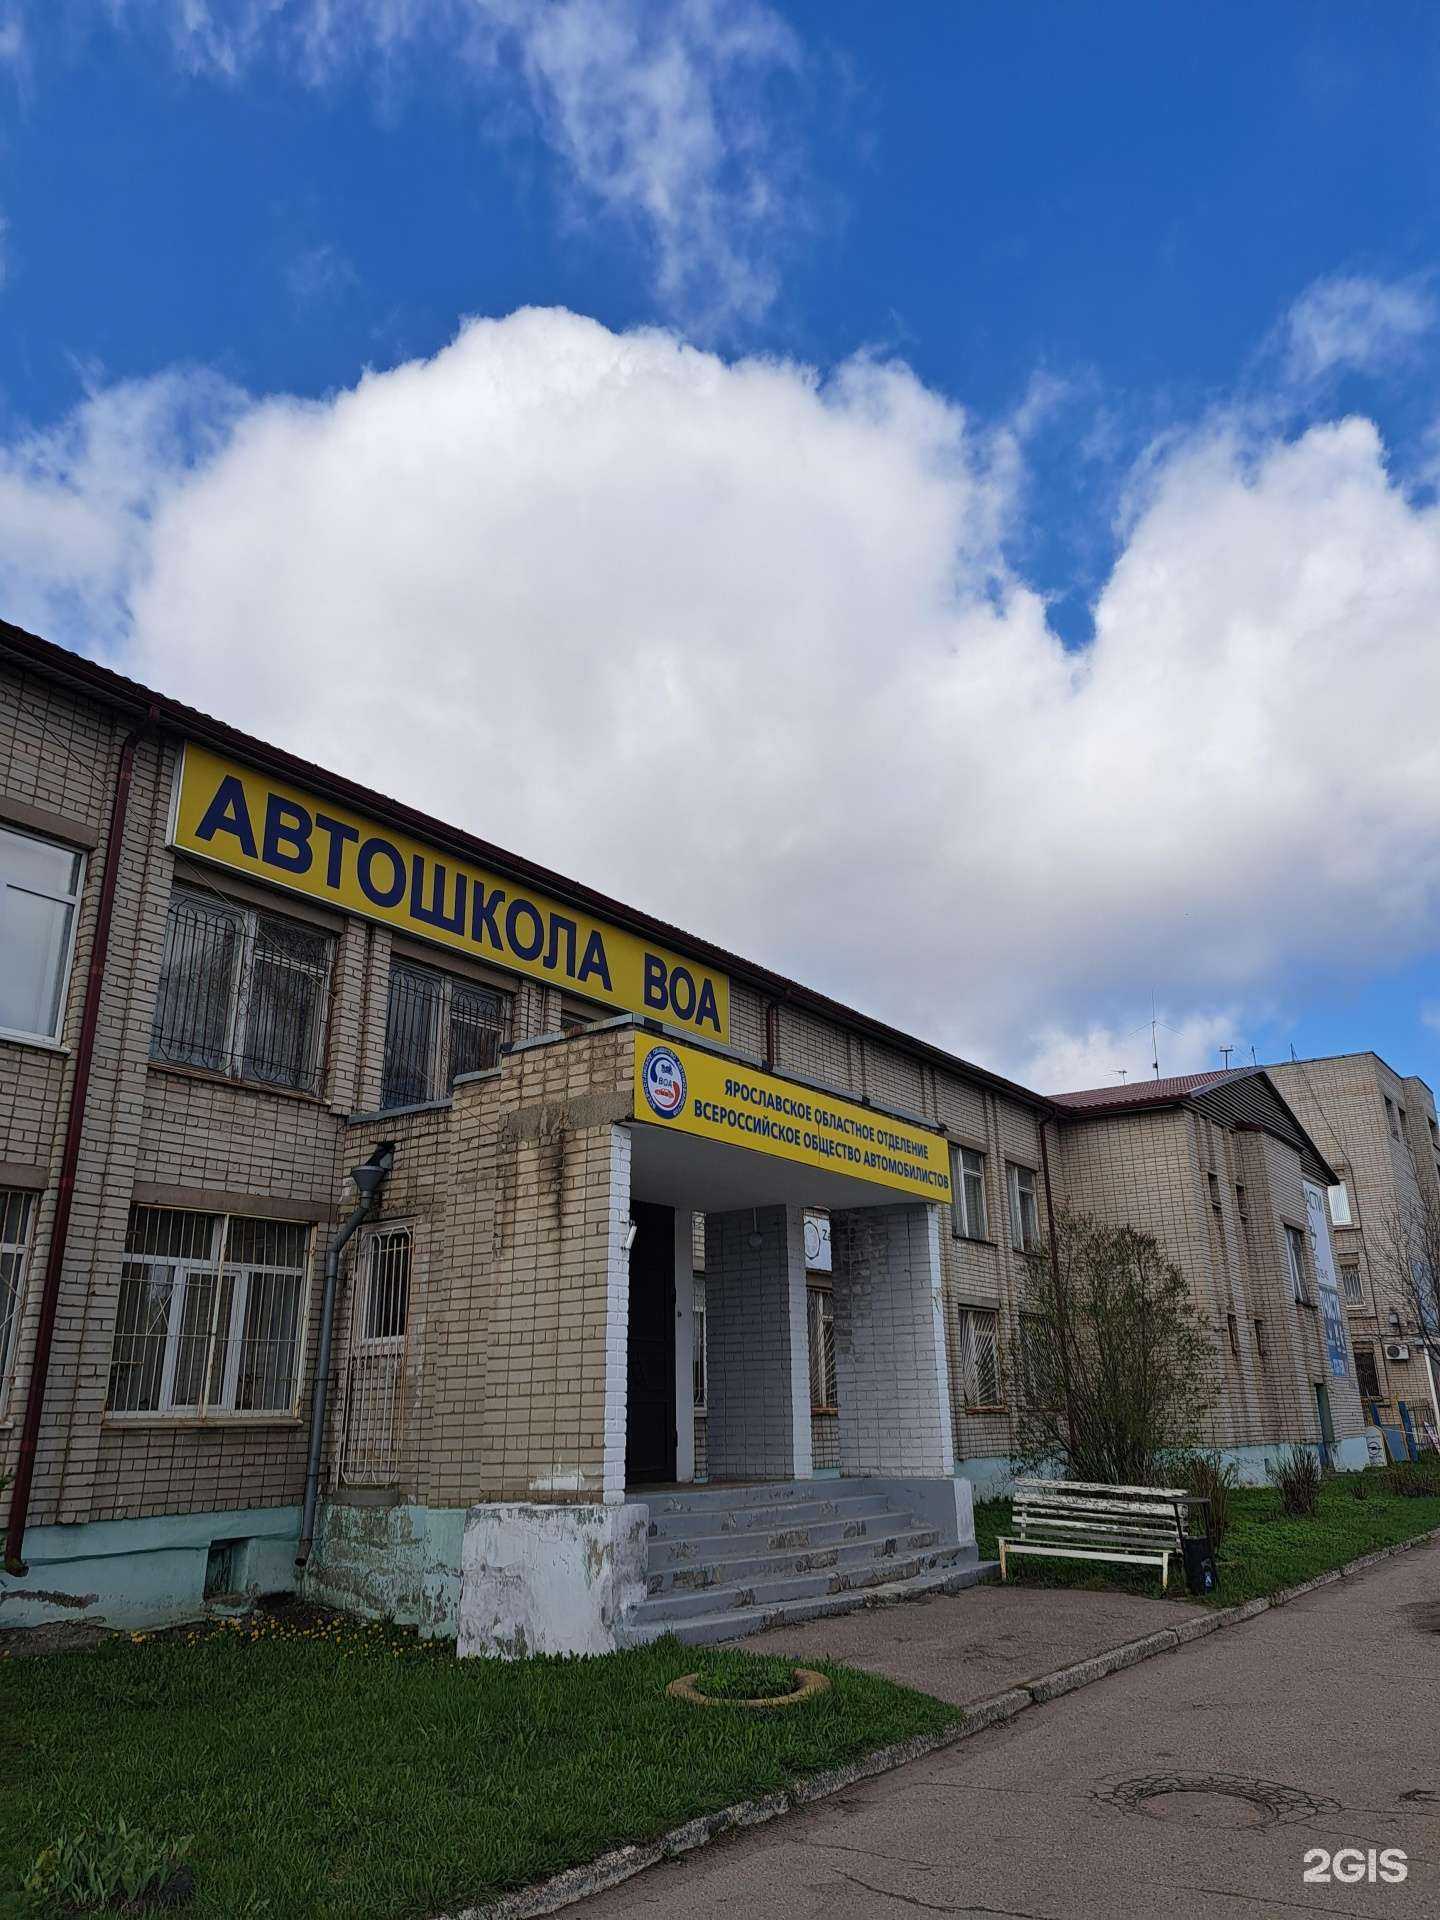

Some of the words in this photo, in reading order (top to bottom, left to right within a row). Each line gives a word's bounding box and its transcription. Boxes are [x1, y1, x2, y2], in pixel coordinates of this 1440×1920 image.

[194, 774, 613, 992] АВТОШКОЛА
[643, 952, 722, 1033] ВОА
[694, 1099, 801, 1146] ВСЕРОССИЙСКОЕ
[803, 1132, 861, 1163] ОБЩЕСТВО
[863, 1150, 949, 1189] АВТОМОБИЛИСТОВ
[724, 1079, 812, 1121] ЯРОСЛАВСКОЕ
[814, 1108, 875, 1142] ОБЛАСТНОЕ
[877, 1129, 929, 1160] ОТДЕЛЕНИЕ
